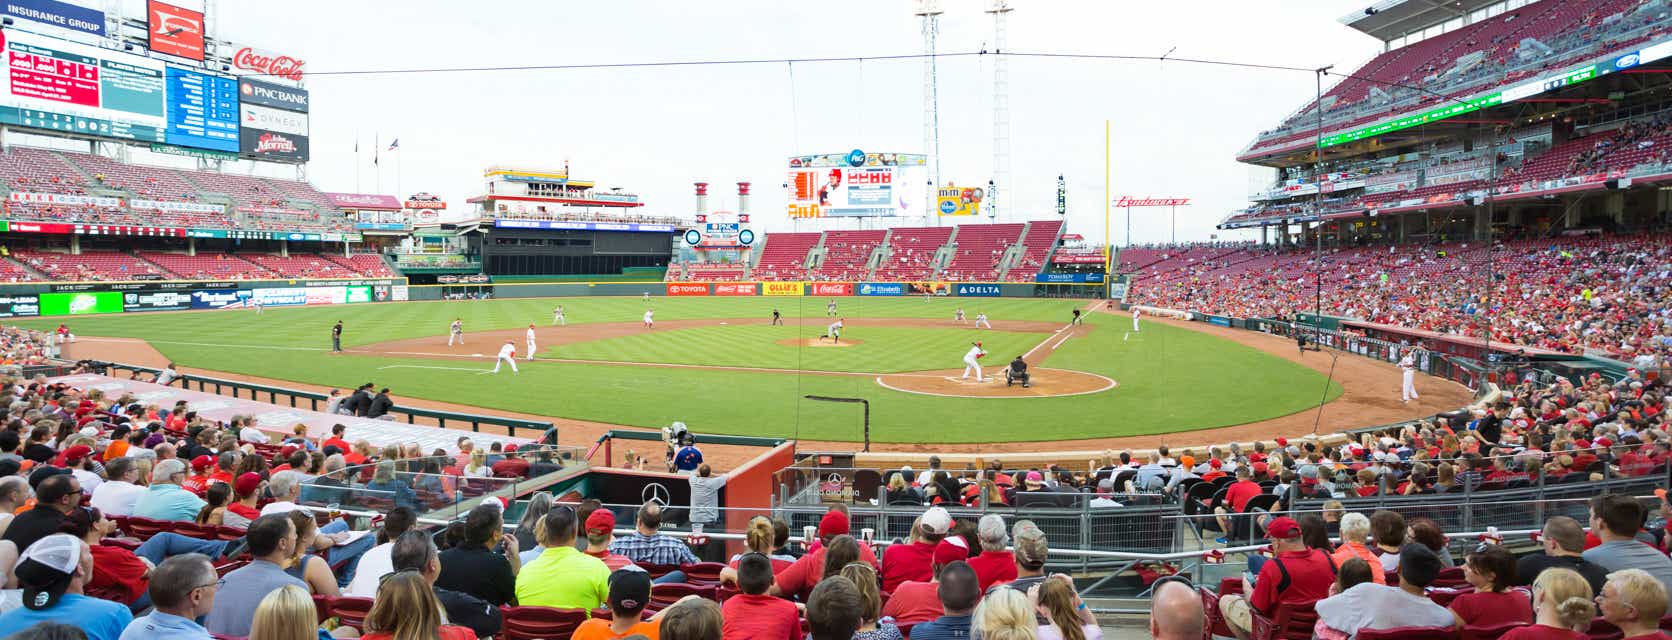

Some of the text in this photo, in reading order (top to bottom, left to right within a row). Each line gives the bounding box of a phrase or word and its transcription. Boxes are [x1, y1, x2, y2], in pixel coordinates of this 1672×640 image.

[8, 4, 100, 32] INSURANCE GROUP
[233, 47, 305, 81] Coca-Cola
[418, 201, 443, 209] TOYOTA
[679, 286, 707, 294] TOYOTA
[969, 285, 1001, 294] DELTA
